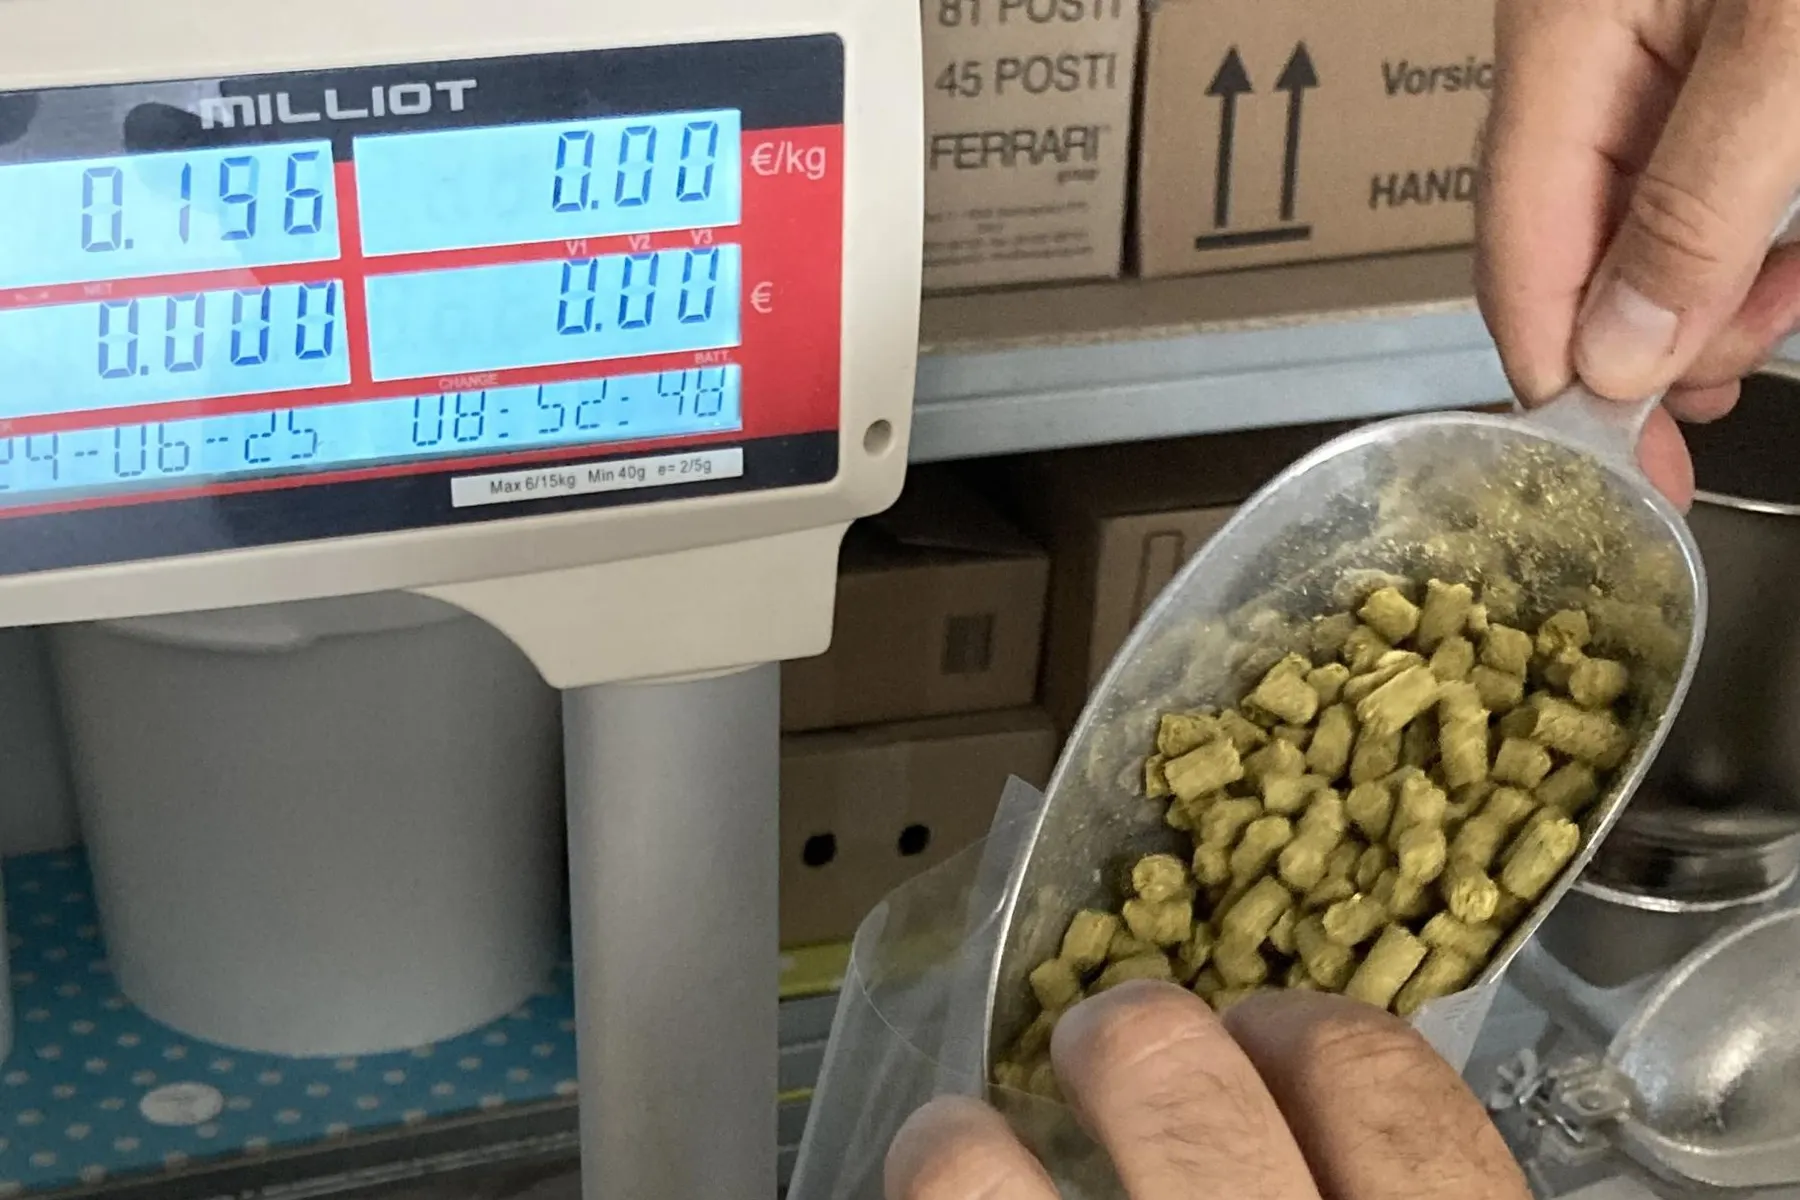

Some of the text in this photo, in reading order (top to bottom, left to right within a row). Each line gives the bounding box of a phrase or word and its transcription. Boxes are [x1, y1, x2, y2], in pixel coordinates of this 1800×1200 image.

[934, 53, 1116, 98] 45 POSTI
[200, 79, 477, 129] MILLIOT
[553, 120, 718, 212] 0.00
[751, 140, 826, 180] €/kg
[929, 124, 1101, 170] FERRARI
[81, 150, 323, 252] 0.196
[1368, 165, 1480, 211] HAND
[566, 229, 713, 256] V1 V2 V3
[557, 247, 719, 335] 0.00
[750, 281, 773, 314] €
[98, 278, 337, 379] 0.000
[438, 373, 498, 390] CHANGE
[490, 458, 712, 495] Max 6/15kg Min 40g e= 2/5g
